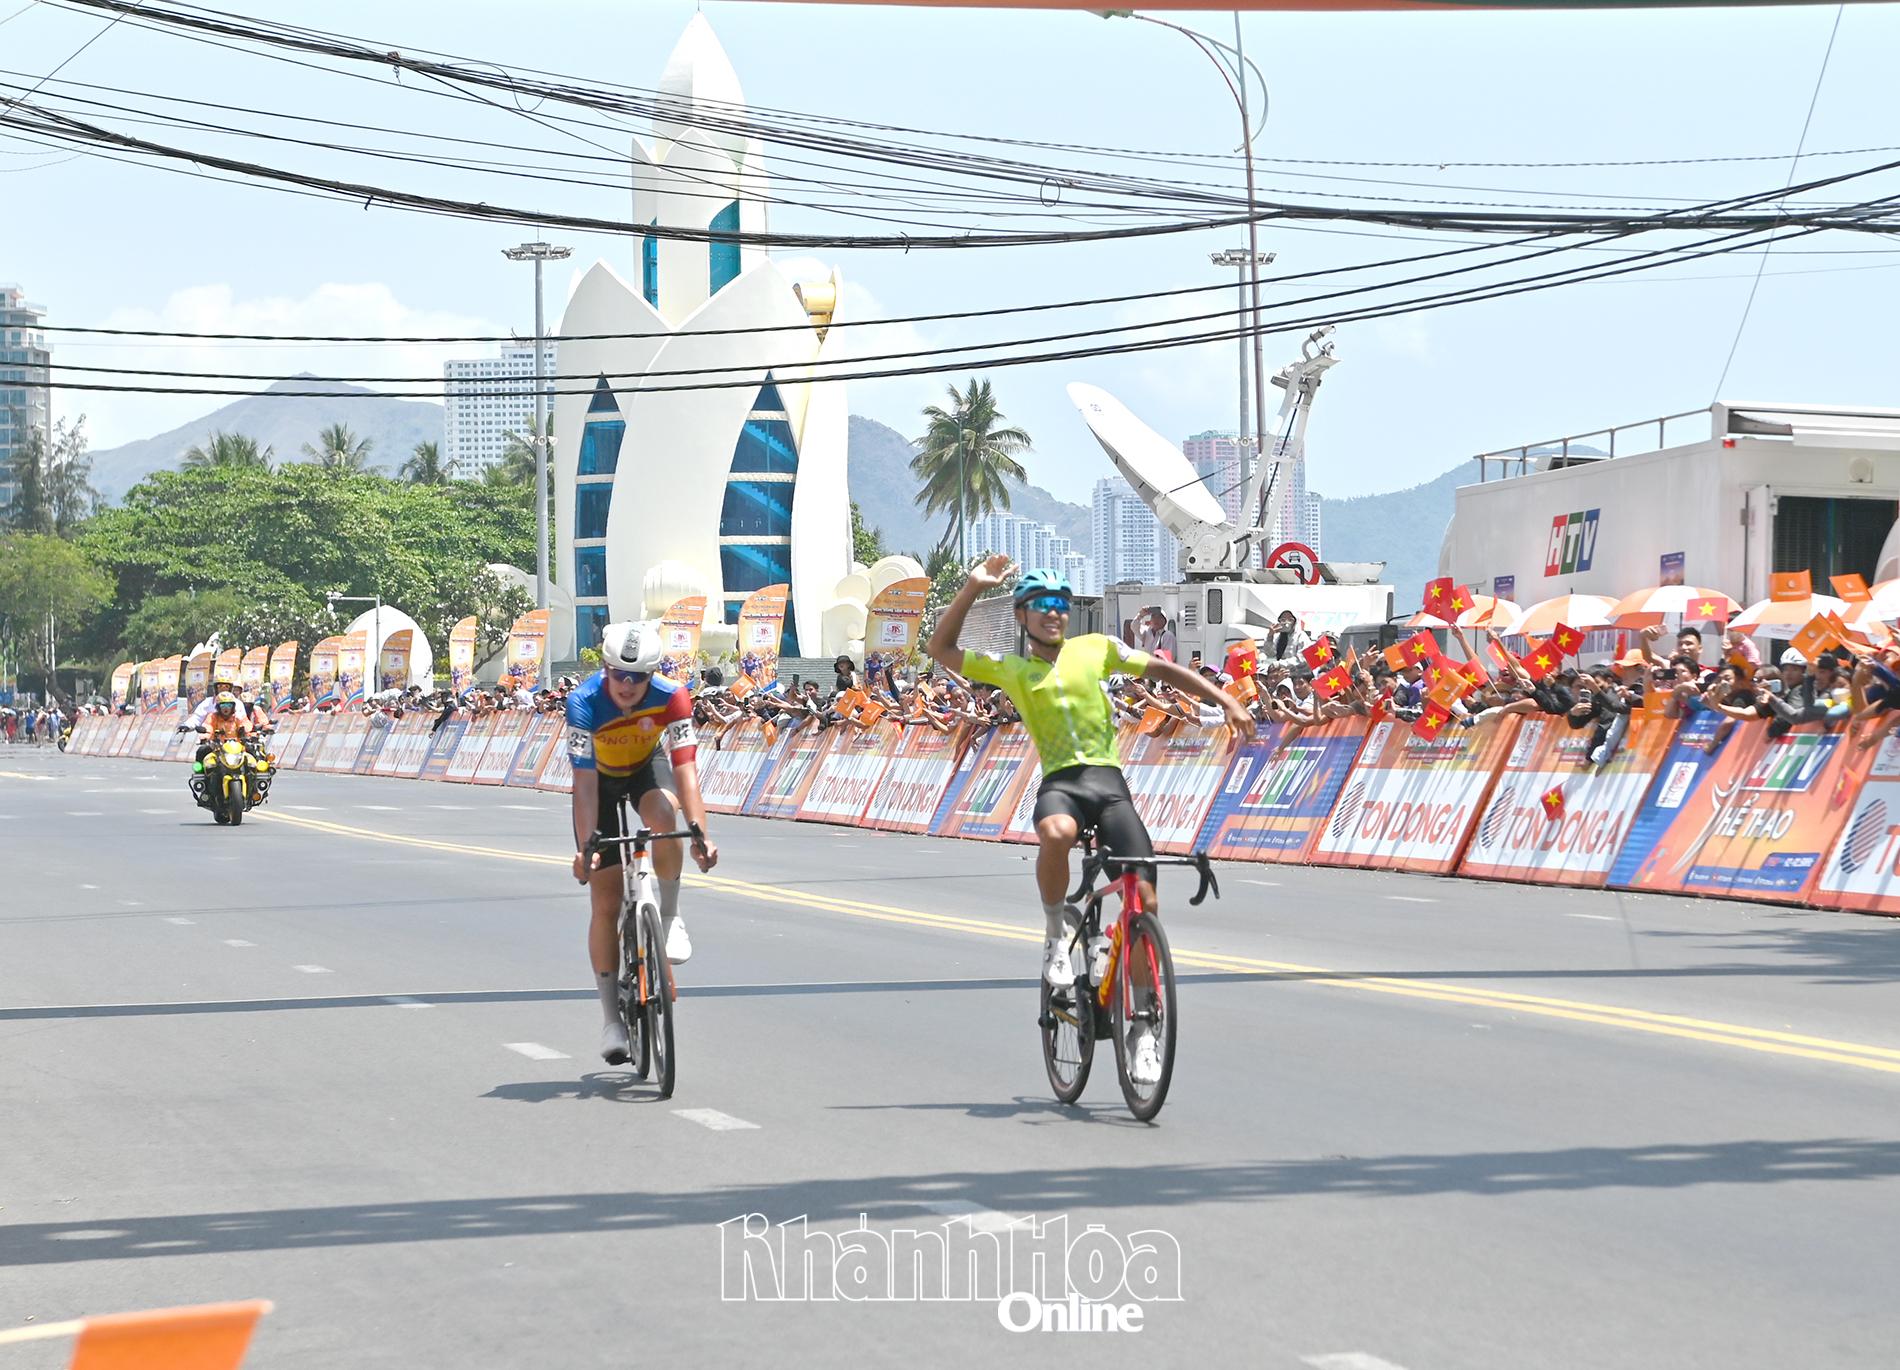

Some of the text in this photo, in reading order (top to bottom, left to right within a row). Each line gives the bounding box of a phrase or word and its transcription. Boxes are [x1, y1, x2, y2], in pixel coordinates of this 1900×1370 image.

[1546, 517, 1598, 569] HTV
[1249, 758, 1316, 797] HTV
[1743, 808, 1795, 840] THAO
